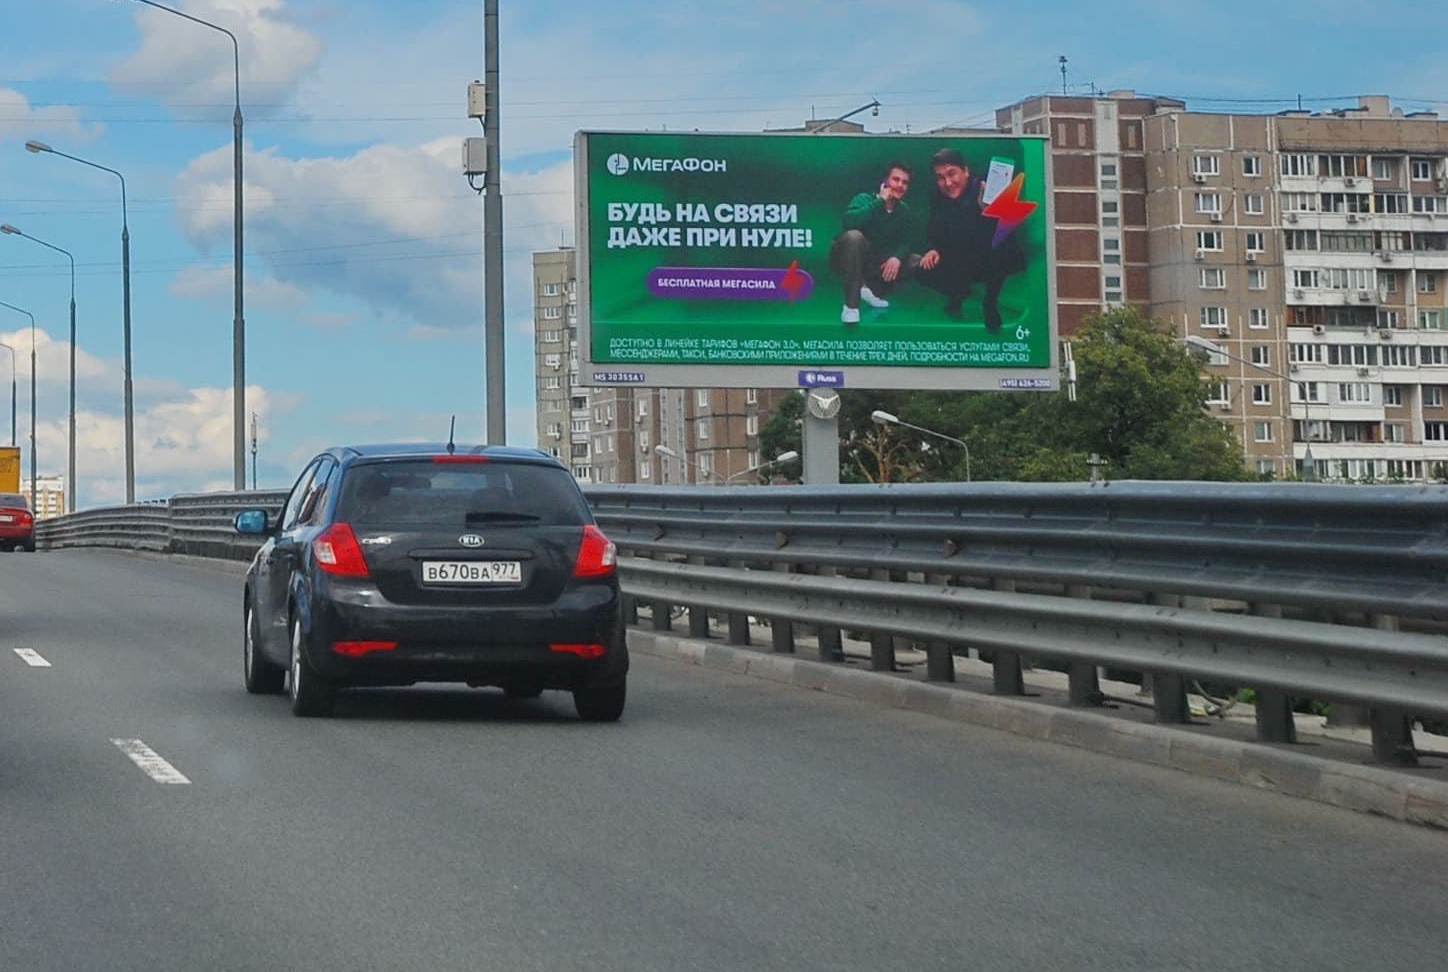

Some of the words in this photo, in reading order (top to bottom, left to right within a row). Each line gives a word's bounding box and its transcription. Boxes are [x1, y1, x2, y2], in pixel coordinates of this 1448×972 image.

[607, 202, 671, 224] БУДЬ
[676, 203, 710, 223] НА
[714, 203, 798, 223] СВЯЗИ
[607, 227, 681, 248] ДАЖЕ
[686, 228, 736, 247] ПРИ
[741, 228, 813, 247] НУЛЕ!
[658, 278, 720, 288] БЕСПЛАТНАЯ
[722, 279, 776, 289] МЕГАСИЛА
[1016, 325, 1031, 340] 6+
[610, 338, 655, 348] ДОСТУПНО
[657, 338, 663, 348] В
[664, 338, 699, 348] ЛИНЕЙКЕ
[702, 339, 738, 349] ТАРИФОВ
[803, 340, 844, 350] МЕГАСИЛА
[846, 340, 892, 350] ПОЗВОЛЯЕТ
[895, 341, 957, 351] ПОЛЬЗОВАТЬСЯ
[959, 341, 1000, 351] УСЛУГАМИ
[610, 349, 680, 359] МЕССЕНДЖЕРАМИ,
[708, 349, 764, 359] БАНКОВСКИМИ
[765, 350, 828, 360] ПРИЛОЖЕНИЯМИ
[829, 350, 835, 360] В
[836, 351, 867, 360] ТЕЧЕНИЕ
[910, 352, 968, 361] ПОДРОБНОСТИ
[969, 352, 980, 362] НА
[981, 352, 1030, 362] MEGAFON.RU
[492, 563, 516, 574] 977
